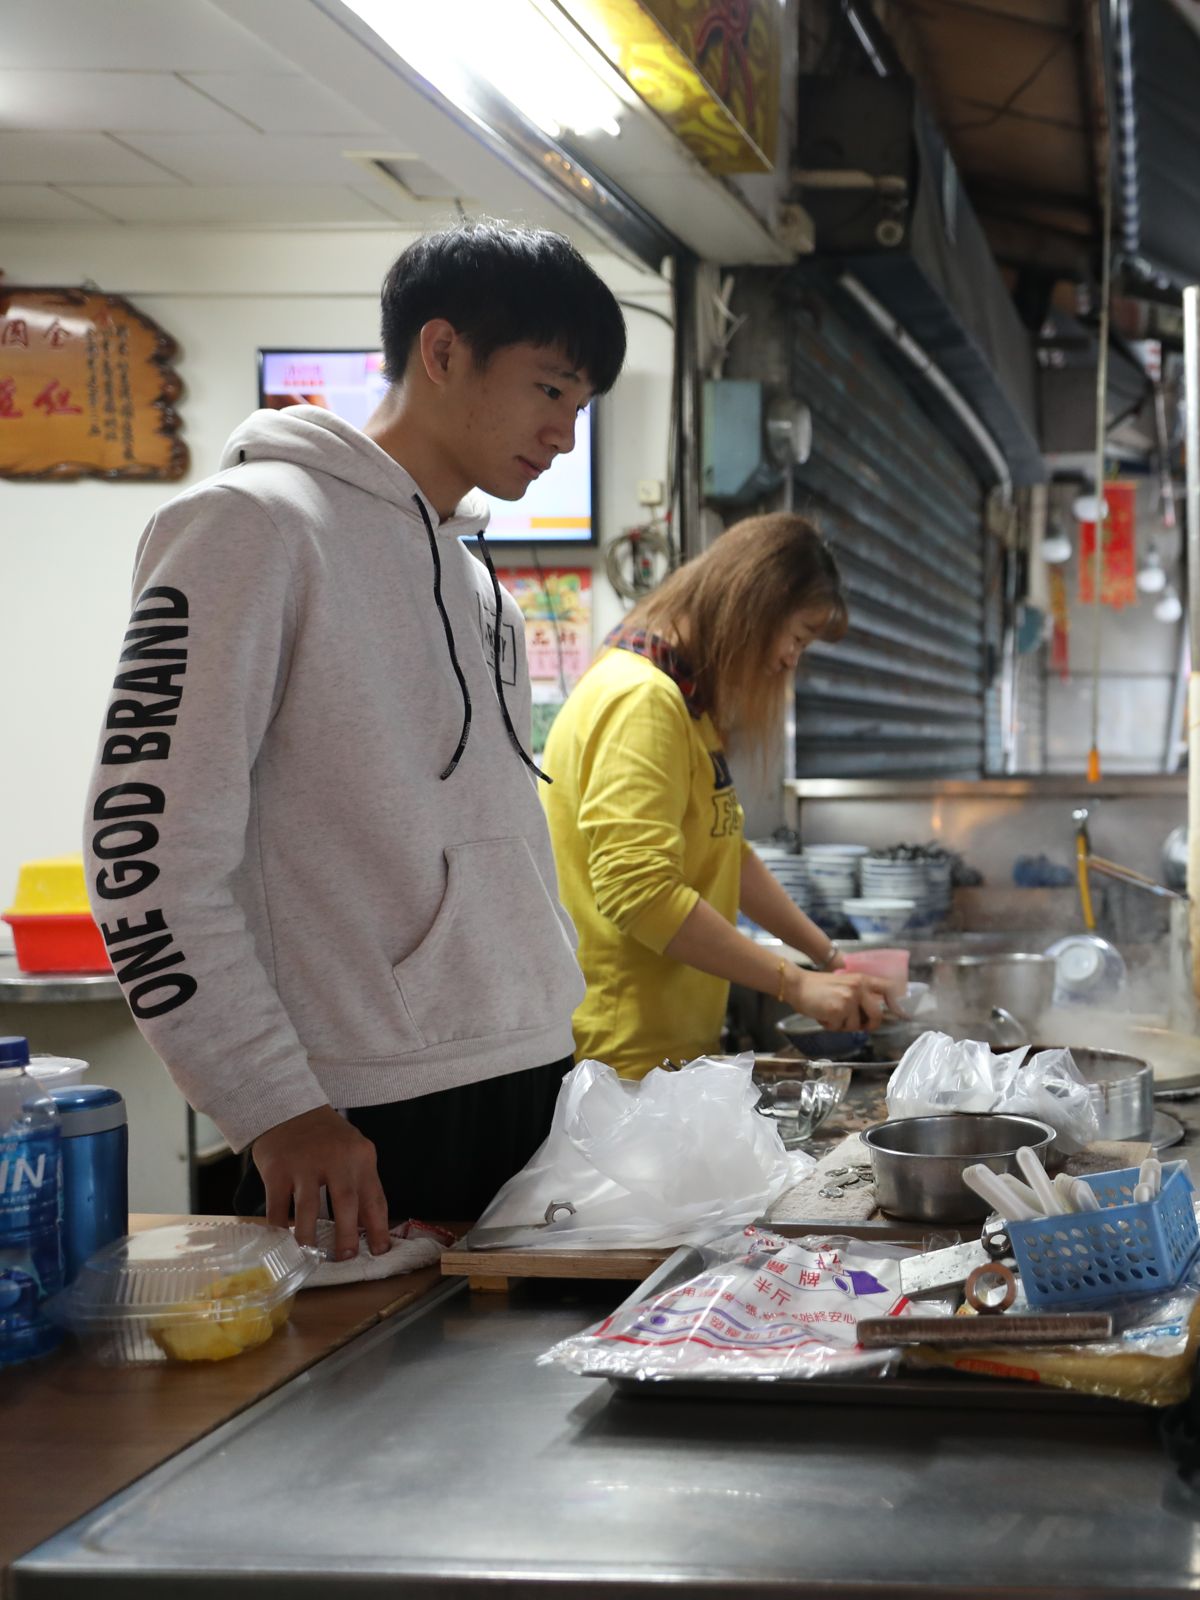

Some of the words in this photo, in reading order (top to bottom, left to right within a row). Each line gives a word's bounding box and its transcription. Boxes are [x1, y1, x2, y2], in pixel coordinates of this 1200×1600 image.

[101, 586, 189, 765] BRAND
[92, 782, 166, 899] GOD
[101, 908, 198, 1019] ONE
[753, 1276, 793, 1307] 半斤
